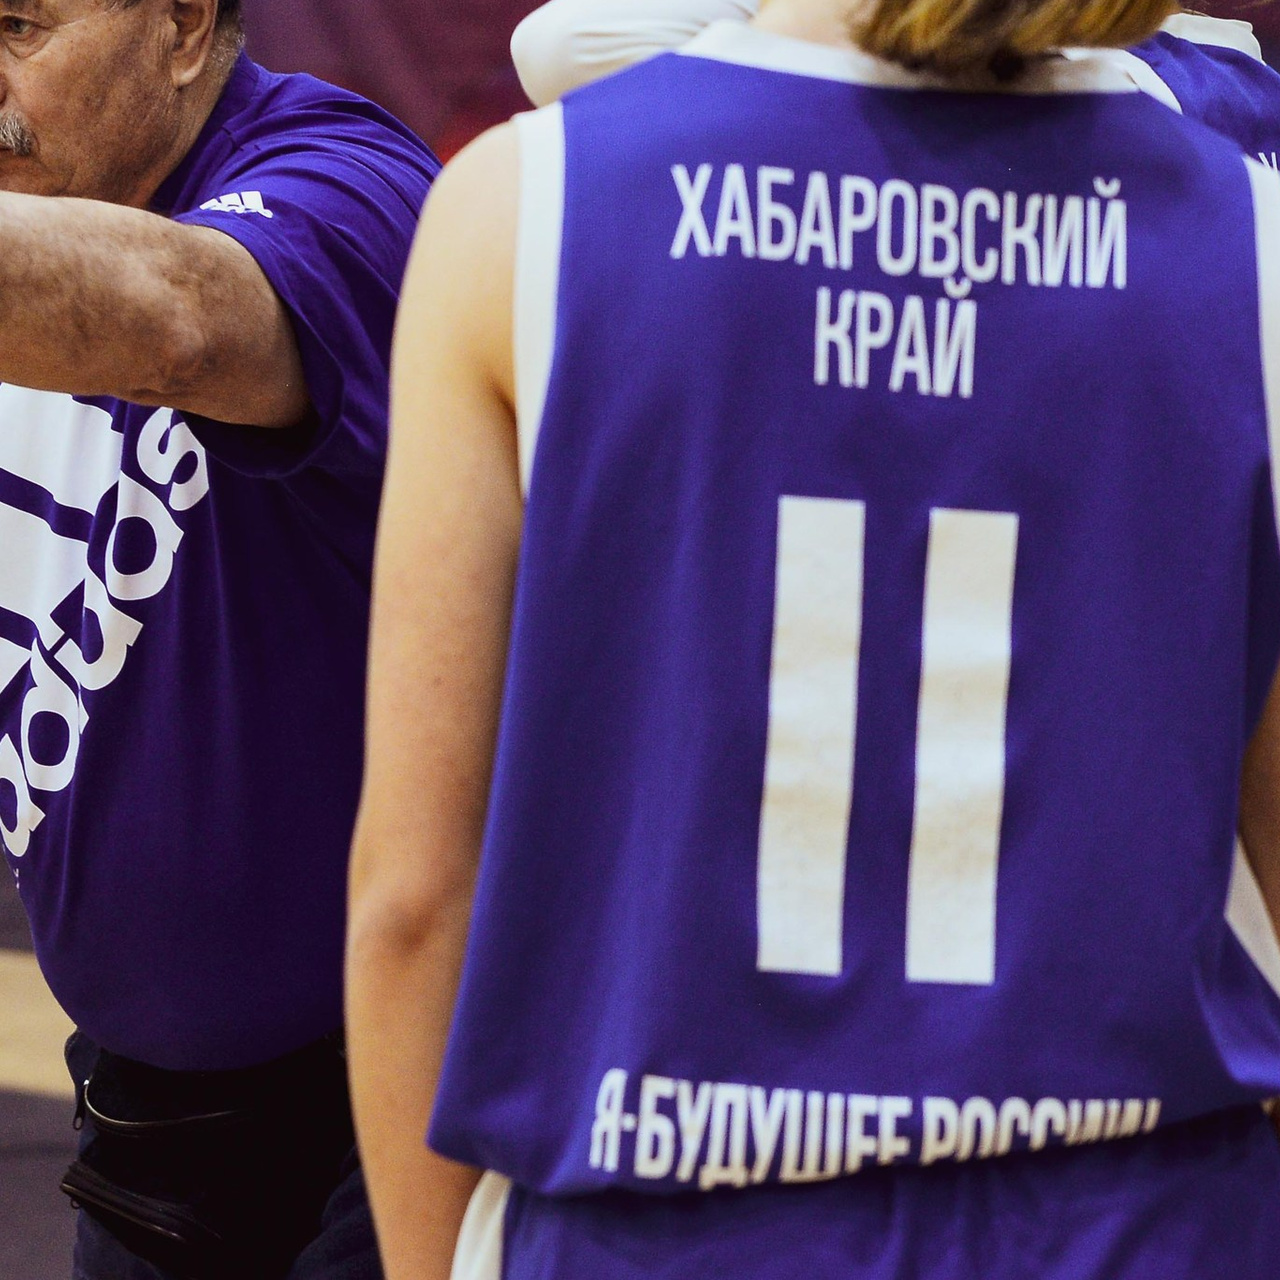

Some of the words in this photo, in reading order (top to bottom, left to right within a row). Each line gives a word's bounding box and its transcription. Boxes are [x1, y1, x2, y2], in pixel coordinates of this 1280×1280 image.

[669, 163, 1128, 290] ХАБАРОВСКИЙ
[813, 277, 978, 399] КРАЙ
[757, 495, 1019, 984] 11
